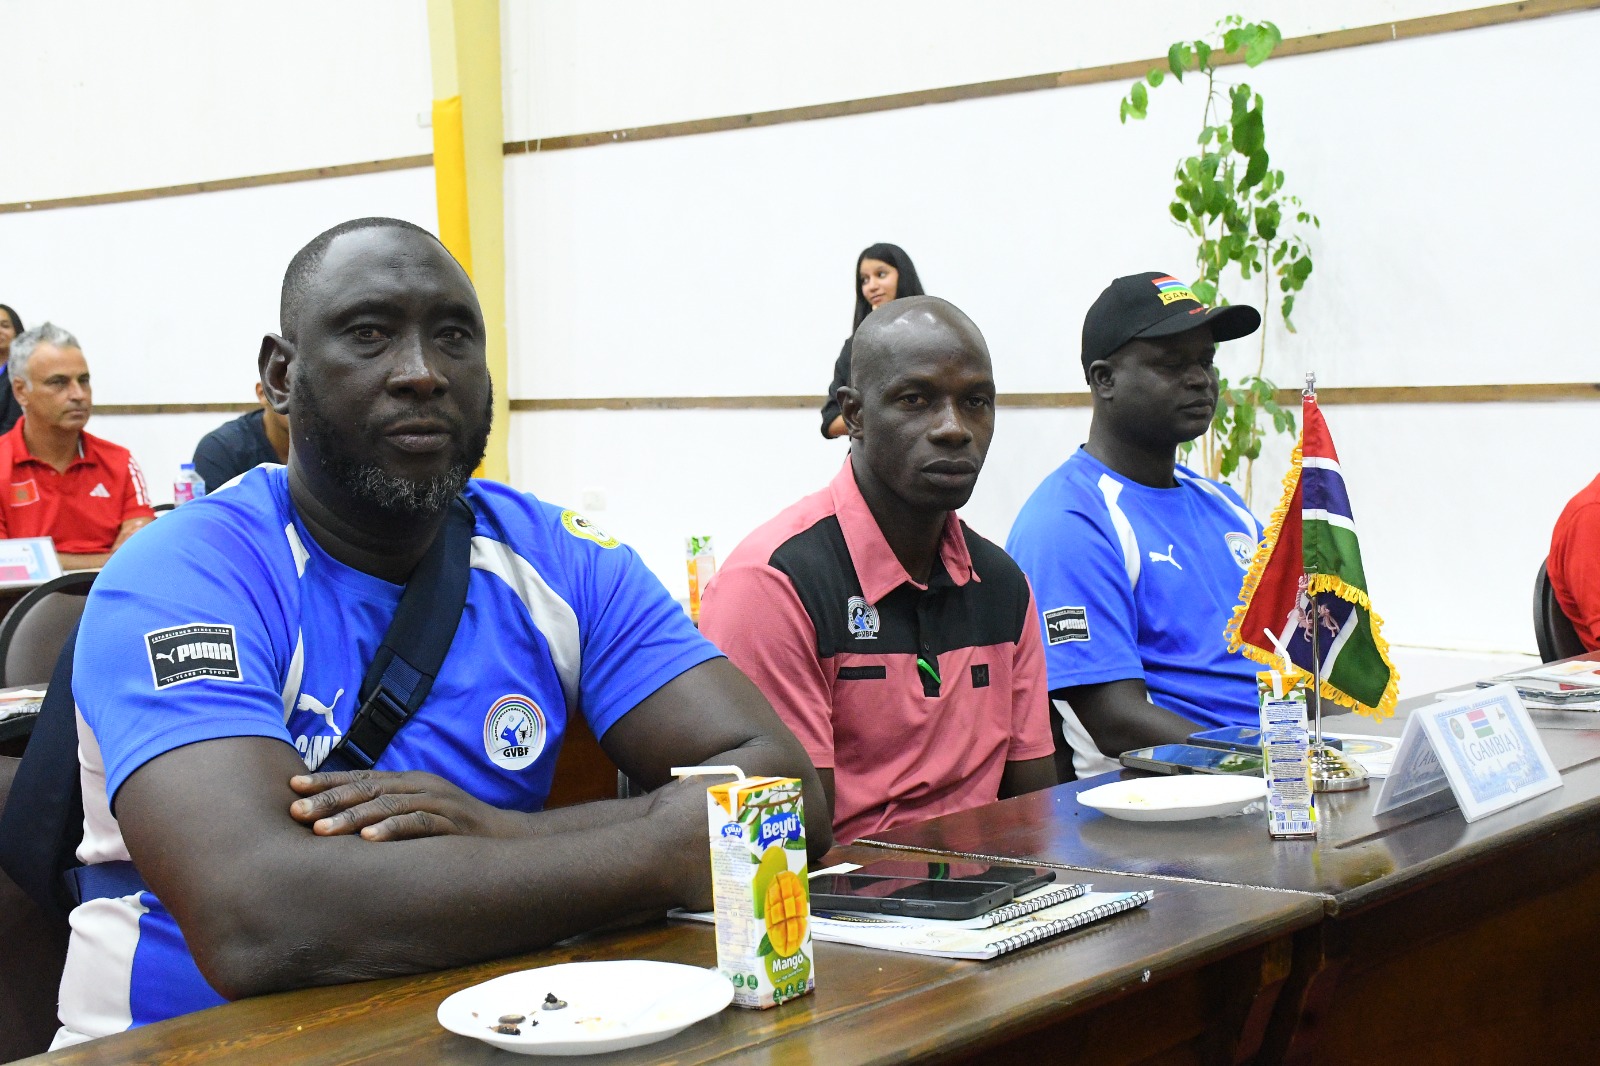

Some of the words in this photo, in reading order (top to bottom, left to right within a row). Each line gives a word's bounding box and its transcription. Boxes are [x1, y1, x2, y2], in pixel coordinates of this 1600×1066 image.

[176, 642, 233, 662] PUMA
[503, 747, 530, 758] GVBF
[762, 814, 797, 839] Beyti
[772, 954, 804, 973] Mango
